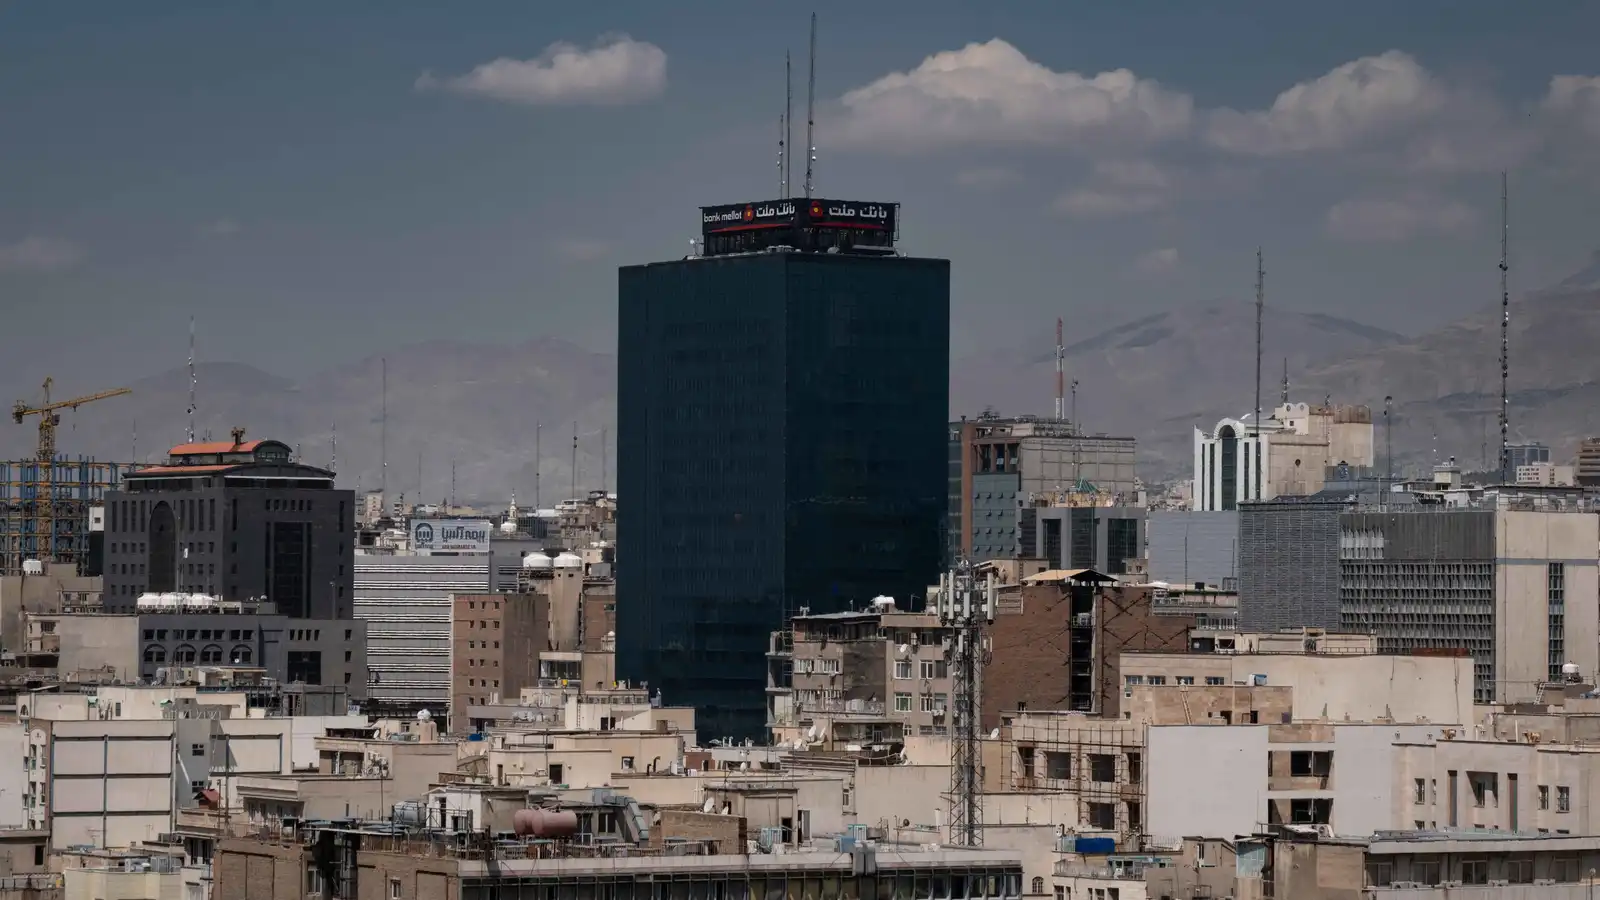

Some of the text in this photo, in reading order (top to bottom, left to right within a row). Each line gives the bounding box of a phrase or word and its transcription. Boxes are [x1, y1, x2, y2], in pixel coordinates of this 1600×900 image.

[703, 210, 742, 223] bank mellat
[756, 204, 775, 217] ملت
[828, 204, 856, 217] ملت
